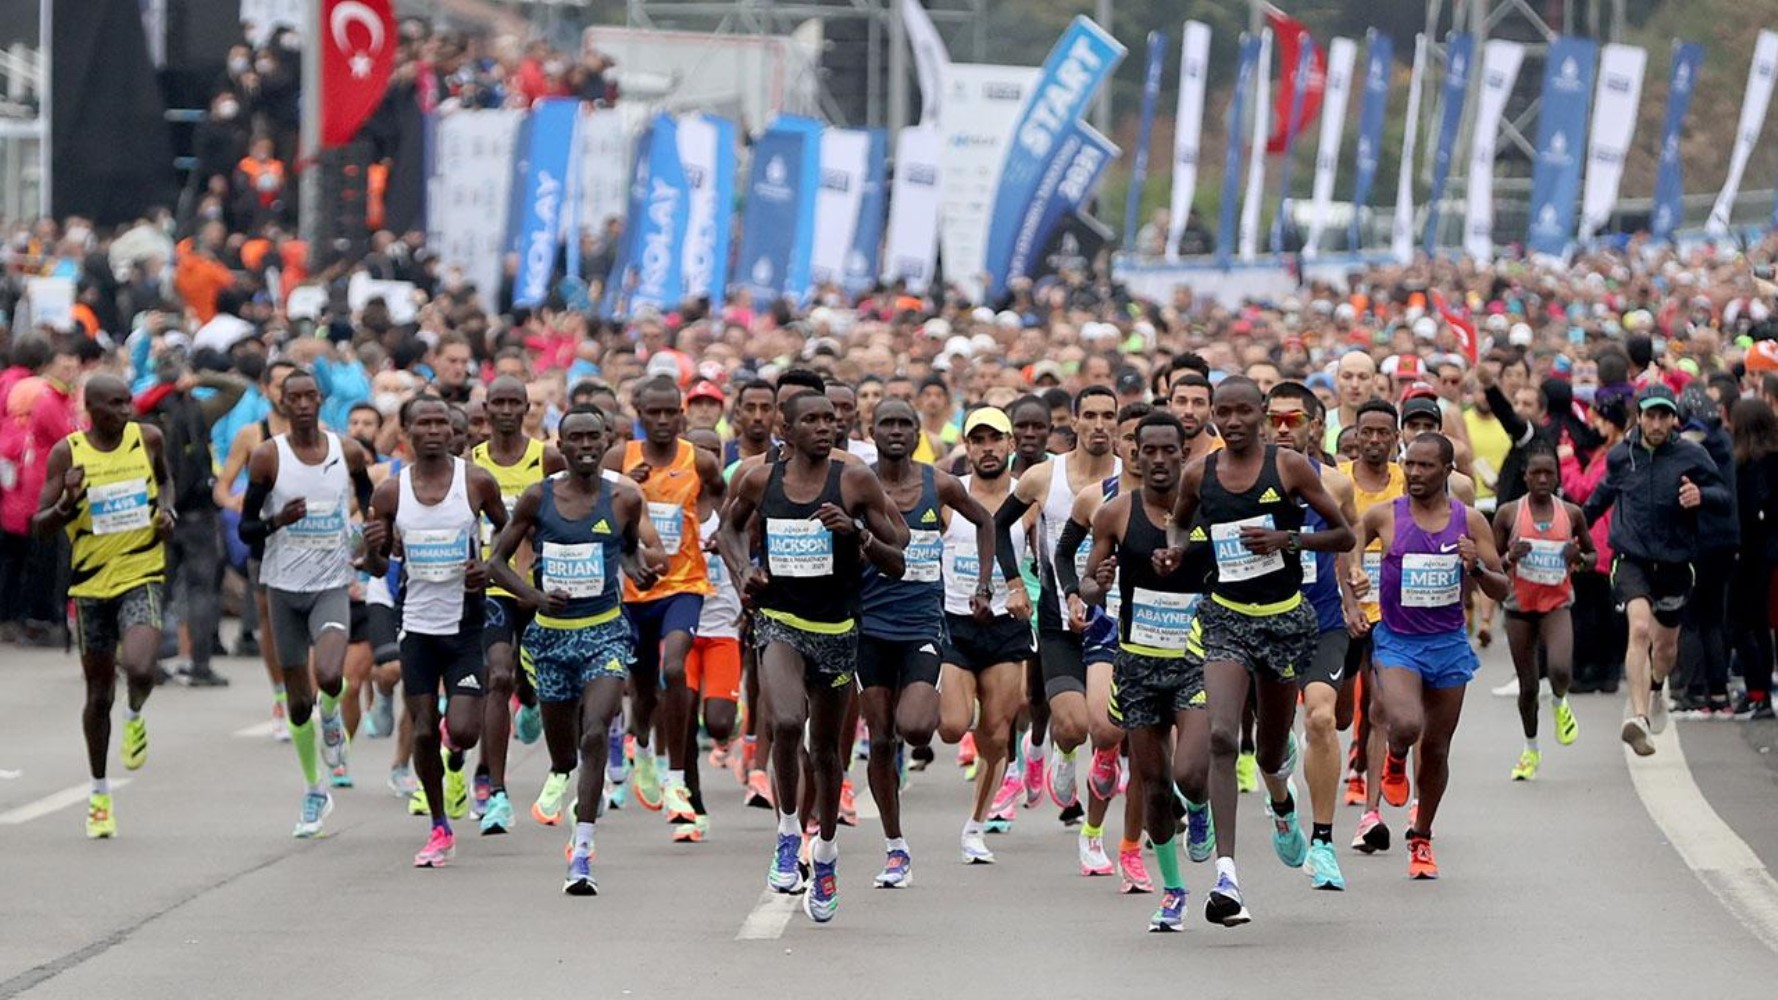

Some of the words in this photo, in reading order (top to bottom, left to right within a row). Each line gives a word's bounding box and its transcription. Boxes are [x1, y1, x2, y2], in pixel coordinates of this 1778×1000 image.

[1020, 34, 1102, 160] START
[522, 170, 562, 300] KOLAY
[638, 175, 680, 297] KOLAY
[547, 559, 600, 577] BRIAN
[770, 537, 828, 552] JACKSON
[1410, 570, 1457, 586] MERT
